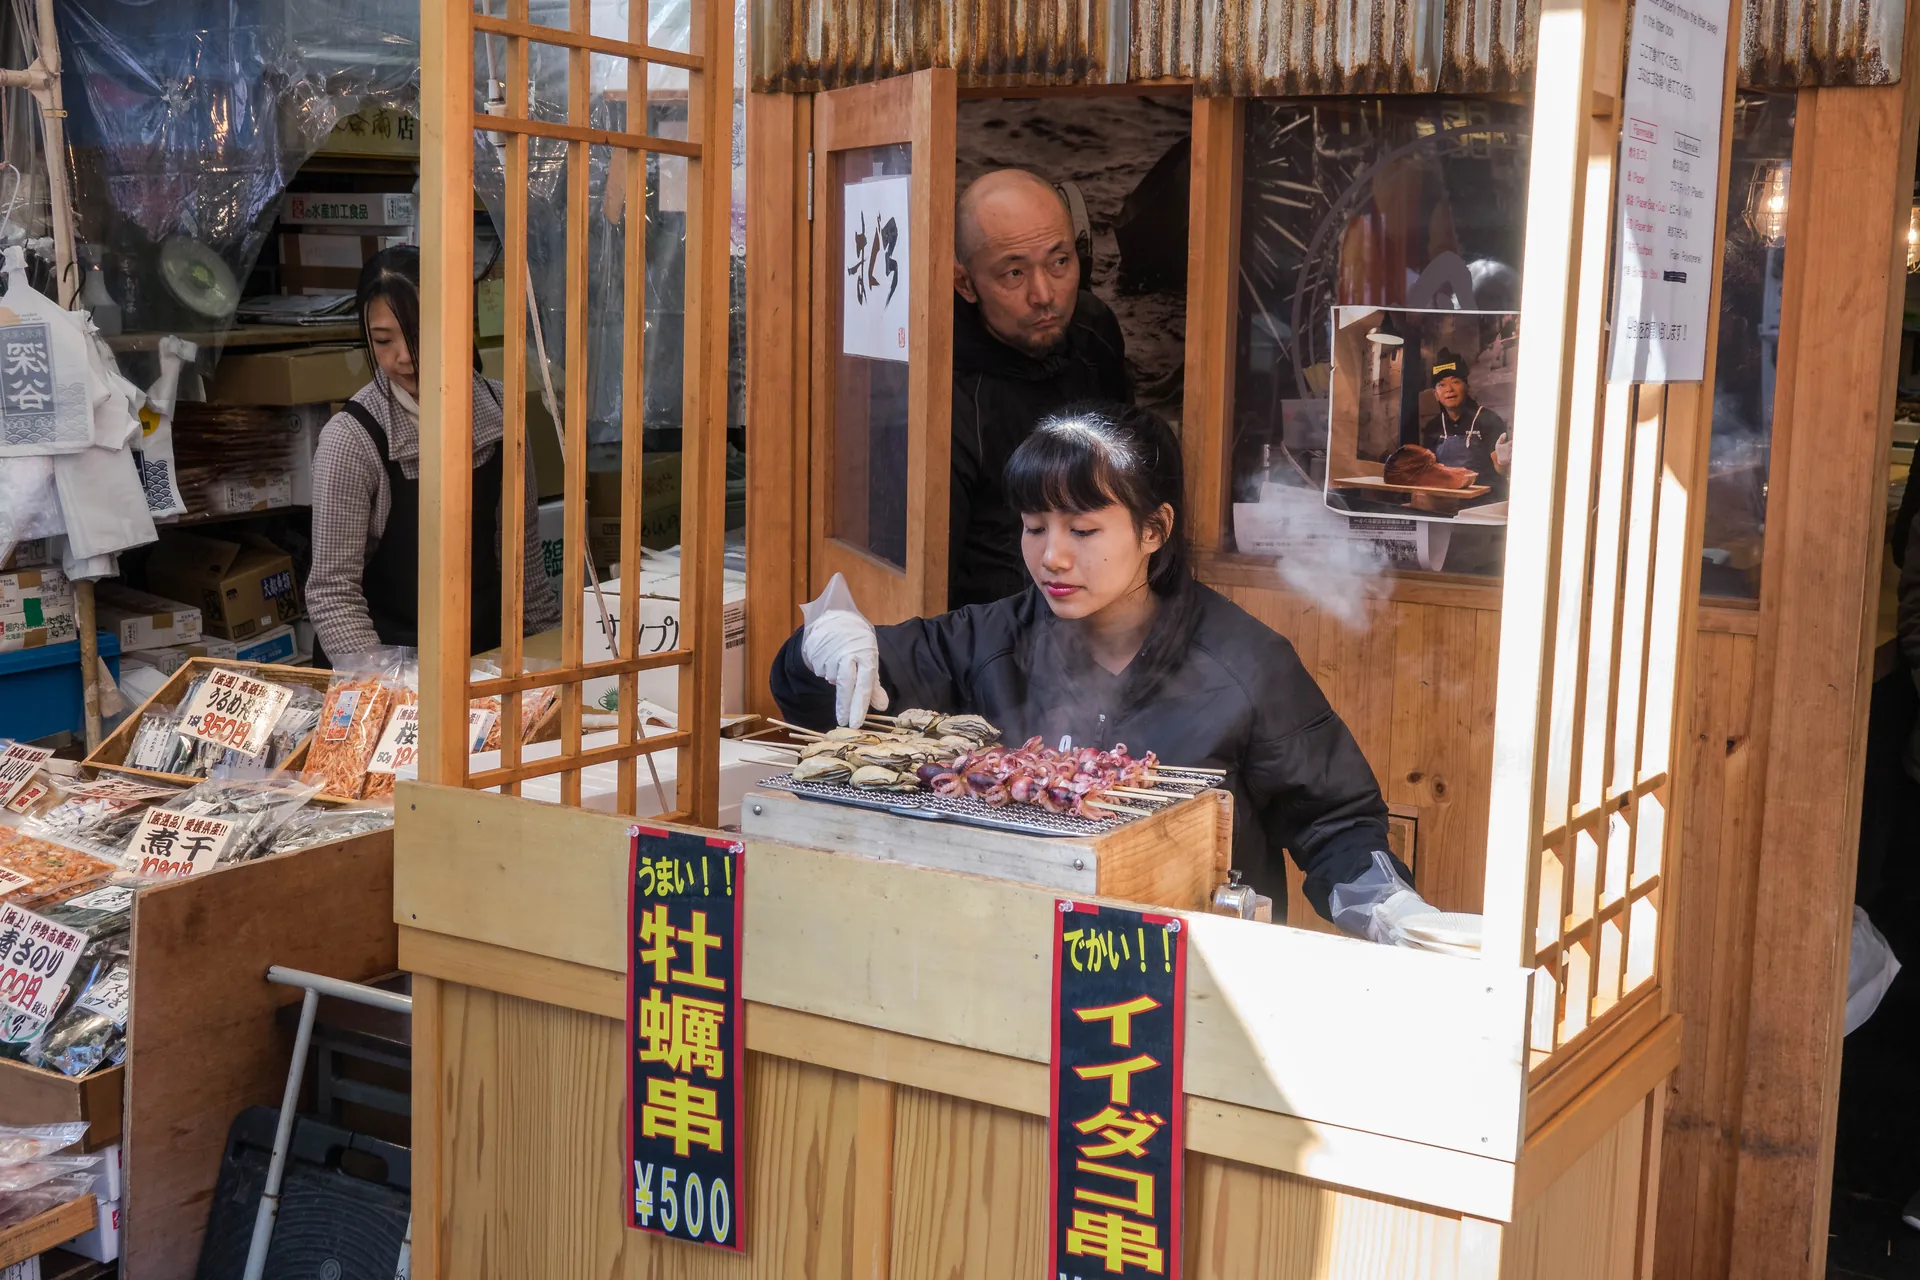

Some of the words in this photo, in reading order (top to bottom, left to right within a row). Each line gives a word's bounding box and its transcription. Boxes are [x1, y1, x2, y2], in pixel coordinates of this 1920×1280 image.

[140, 827, 216, 861] 煮干
[1065, 993, 1167, 1275] イイダコ串
[634, 1159, 730, 1243] ¥500
